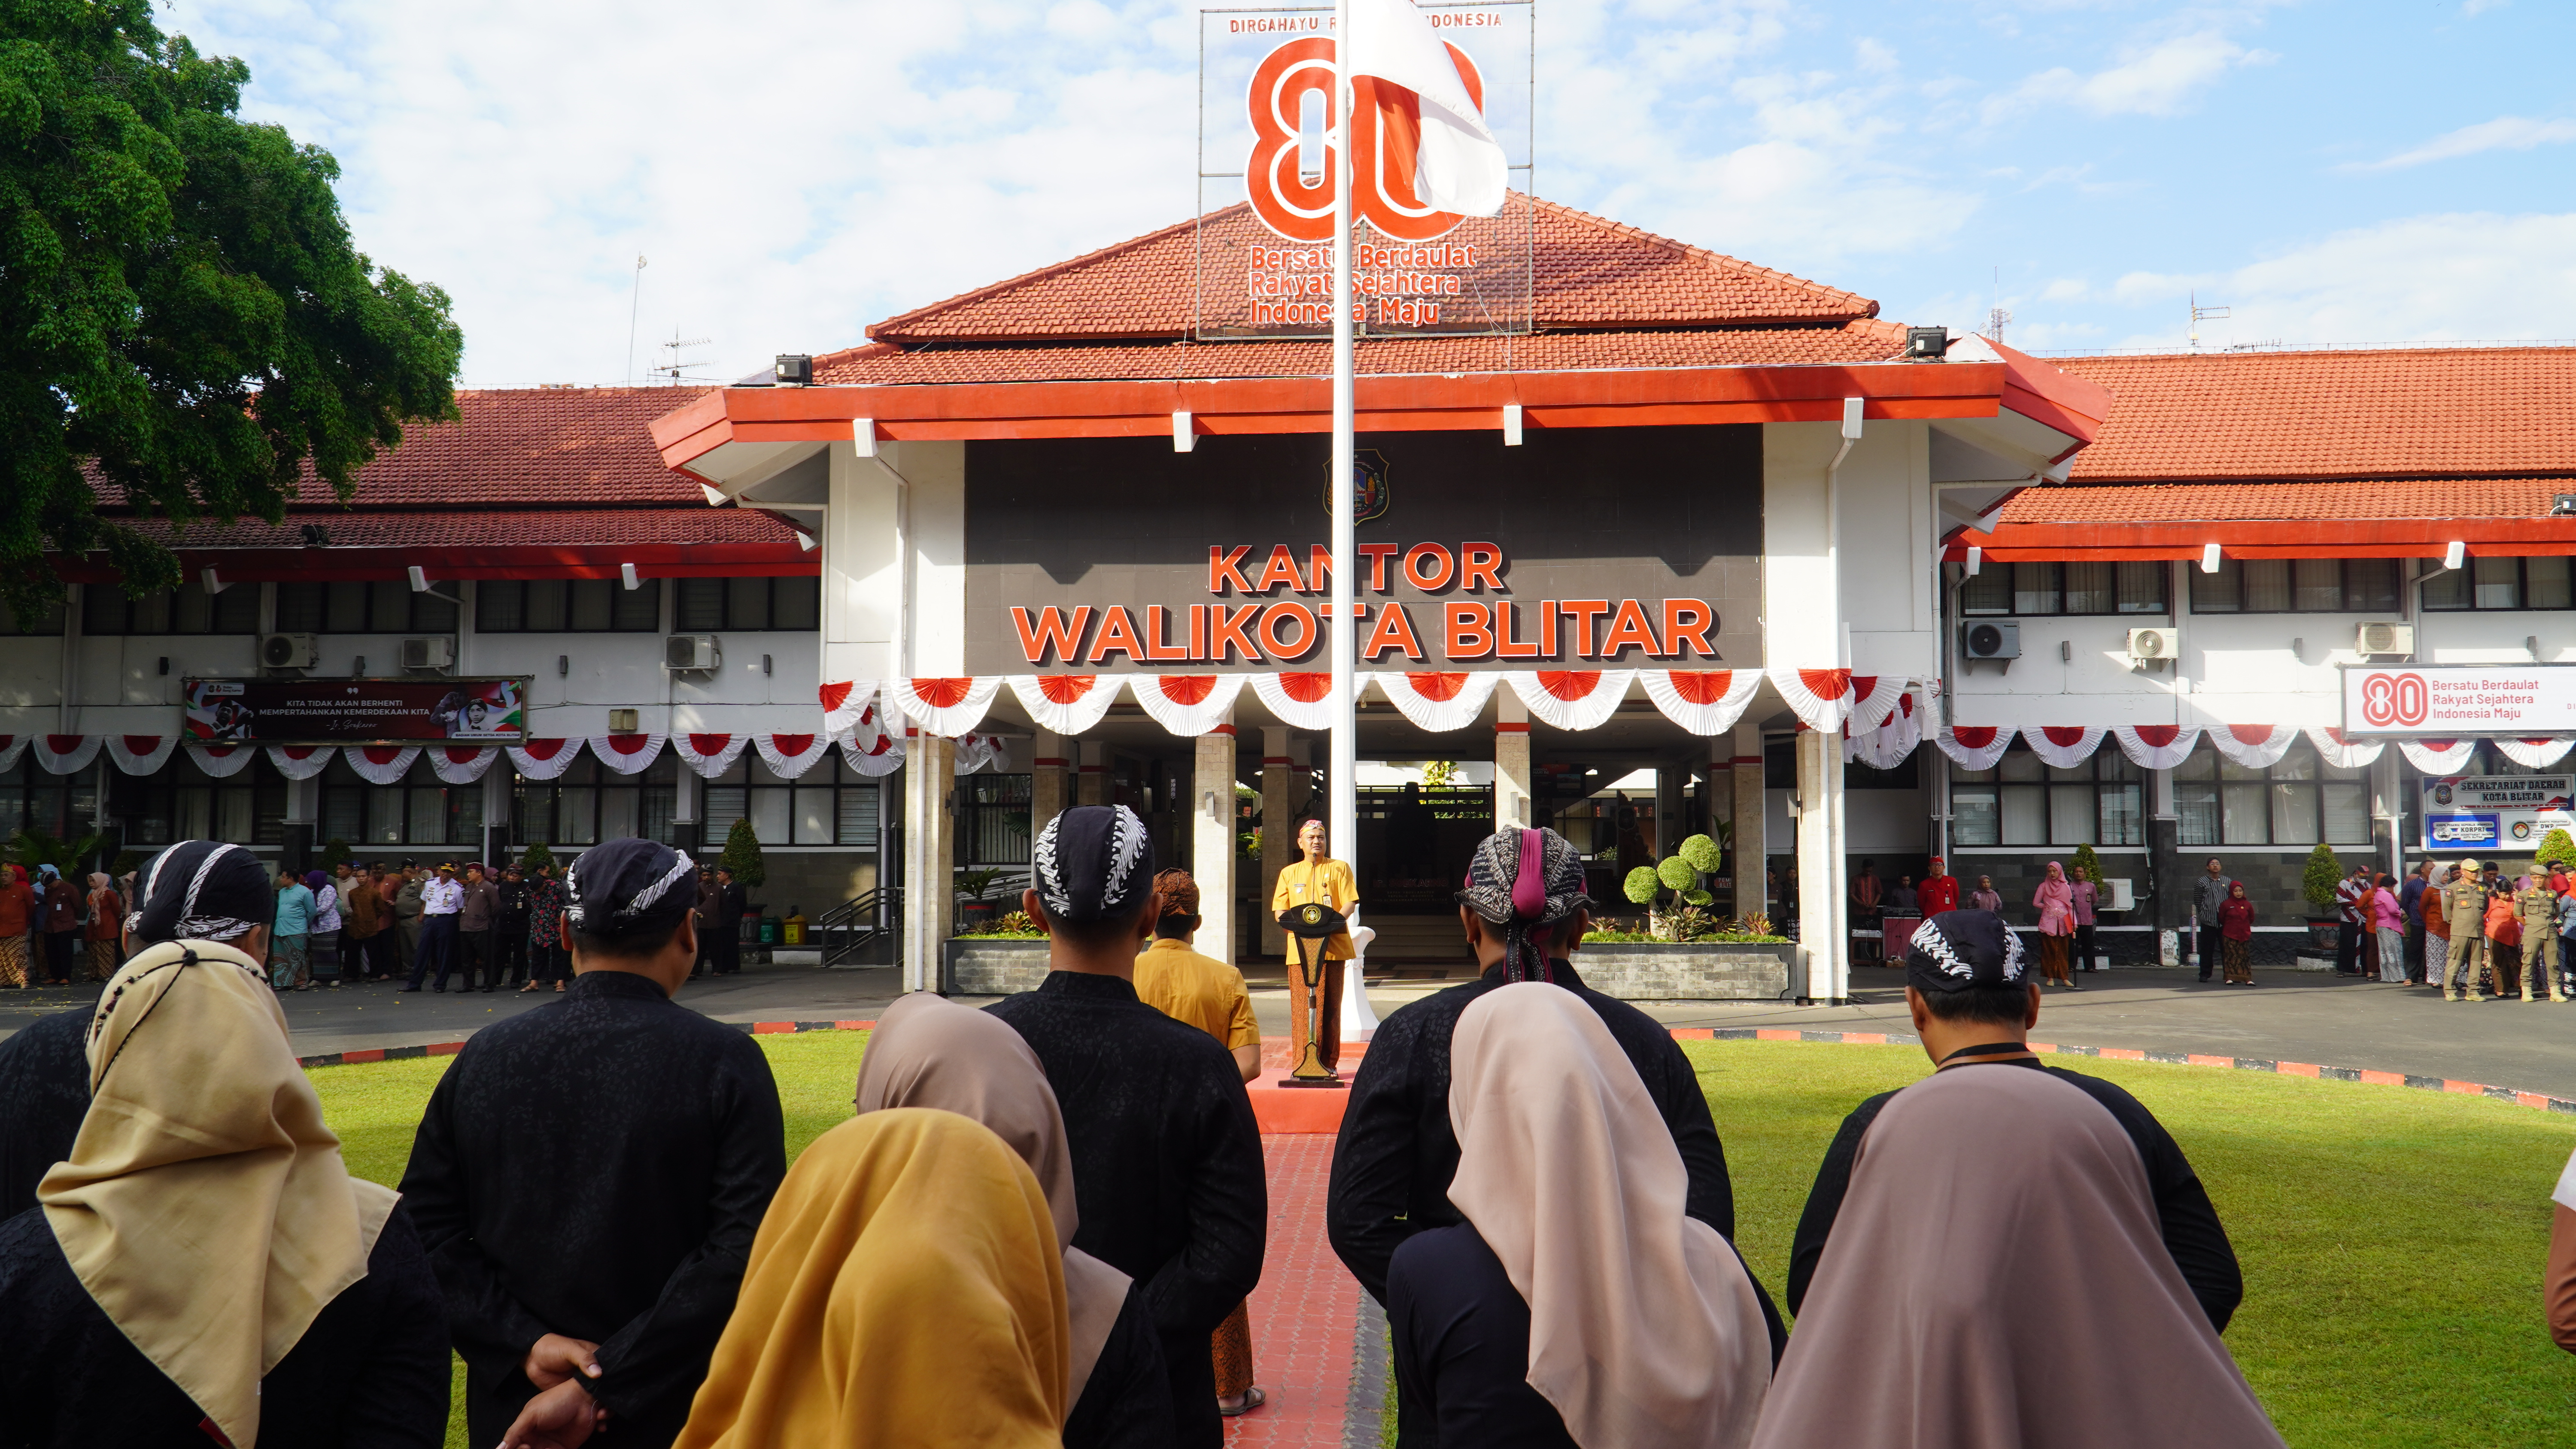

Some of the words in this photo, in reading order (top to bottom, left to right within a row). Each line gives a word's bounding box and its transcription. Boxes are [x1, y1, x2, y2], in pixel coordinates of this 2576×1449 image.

[1230, 16, 1318, 33] DIRGAHAYU
[1426, 13, 1502, 28] DONESIA
[1251, 246, 1335, 270] Bersat
[1358, 243, 1477, 269] Berdaulat
[1250, 271, 1334, 299] Rakyat
[1352, 270, 1461, 298] Sejahtera
[1250, 298, 1367, 325] Indonea
[1379, 297, 1440, 327] Maju
[1444, 598, 1715, 658] BLITAR
[2432, 680, 2479, 690] Bersatu
[2482, 679, 2539, 690] Berdaulat
[2362, 673, 2428, 726] 80
[2433, 694, 2474, 706] Rakyat
[2476, 694, 2534, 706] Sejahtera
[2433, 708, 2491, 718] Indonesia
[2494, 707, 2521, 720] Maju
[2461, 780, 2526, 790] SEKRETARIAT
[2527, 780, 2566, 789] DAERAH
[2482, 793, 2507, 801] KOTA
[2510, 792, 2544, 800] BLITAR
[1389, 878, 1449, 888] SOEKARNO
